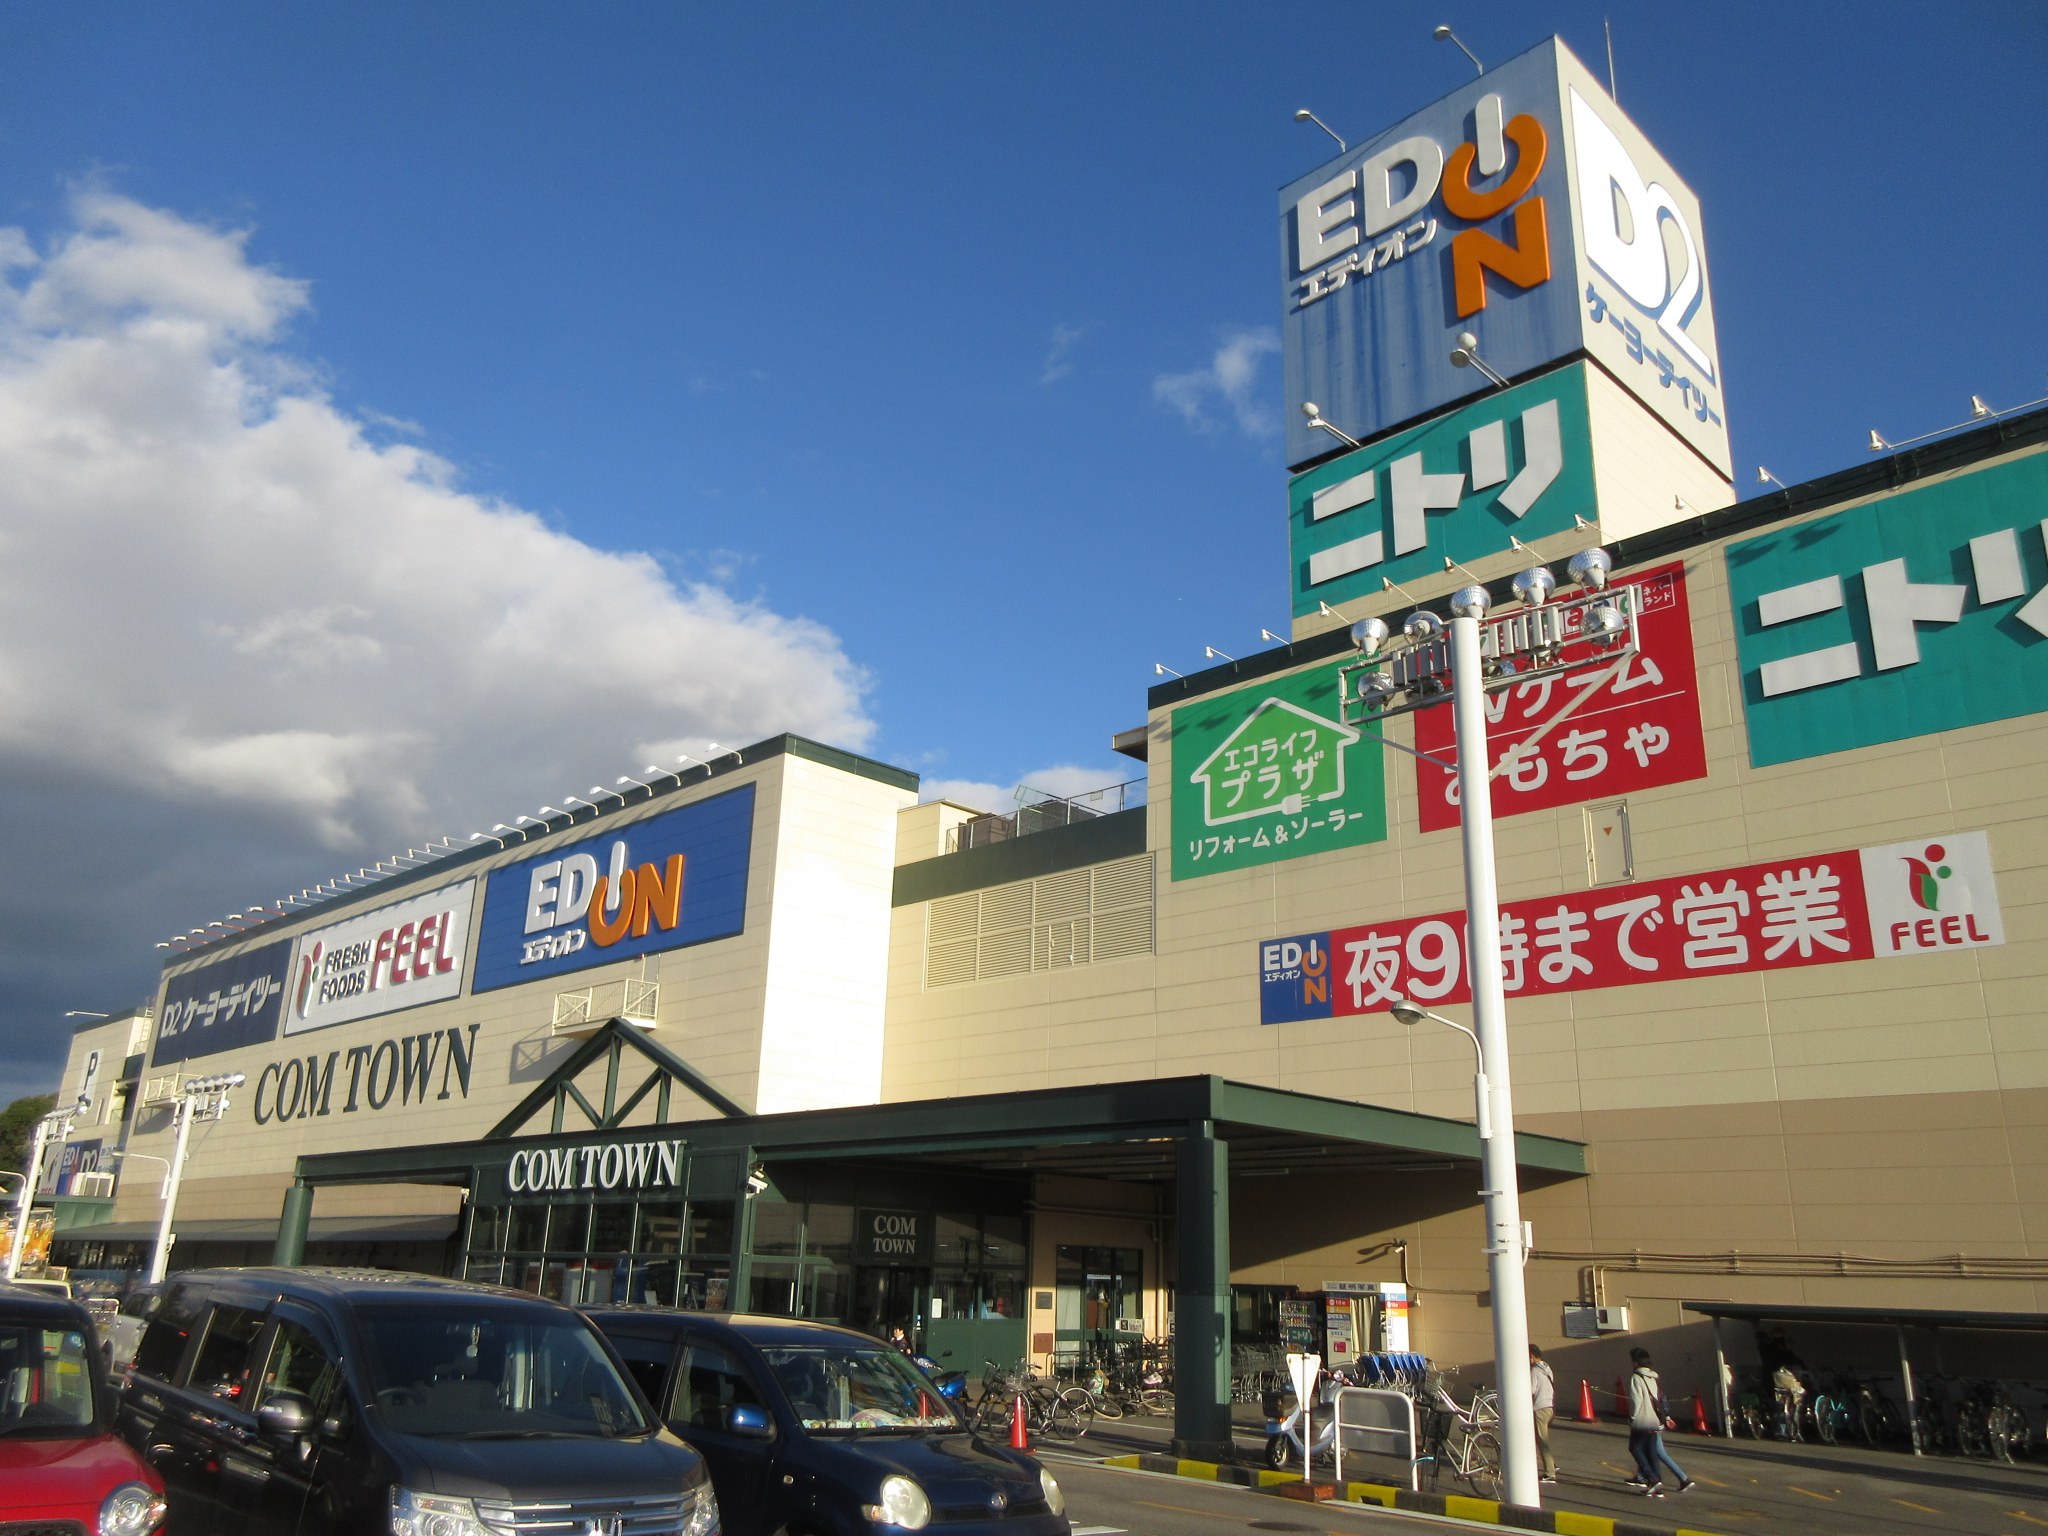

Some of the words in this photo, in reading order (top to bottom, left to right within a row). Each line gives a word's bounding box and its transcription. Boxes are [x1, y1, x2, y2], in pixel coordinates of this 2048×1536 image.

[1298, 93, 1550, 319] EDION
[1299, 219, 1438, 307] エディオン
[1309, 399, 1562, 586] ニトリ
[1643, 581, 1671, 597] ネバー
[1643, 590, 1673, 607] ランド
[1224, 729, 1317, 772] エコライフ
[1221, 750, 1325, 808] プラザ
[1190, 808, 1363, 861] リフォーム&ソーラー
[524, 841, 685, 947] EDION
[368, 910, 456, 993] FEEL
[520, 928, 587, 965] エディオン
[1890, 913, 1989, 951] FEEL
[323, 938, 377, 978] FRESH
[1264, 939, 1327, 1005] EDION
[1264, 969, 1301, 983] エディオン
[318, 969, 369, 1005] FOODS
[160, 1003, 183, 1039] D2
[84, 1051, 99, 1092] P
[254, 1051, 341, 1126] COM
[343, 1023, 481, 1113] TOWN
[508, 1147, 578, 1192] COM
[581, 1139, 687, 1189] TOWN
[873, 1214, 917, 1236] COM
[873, 1237, 916, 1255] TOWN
